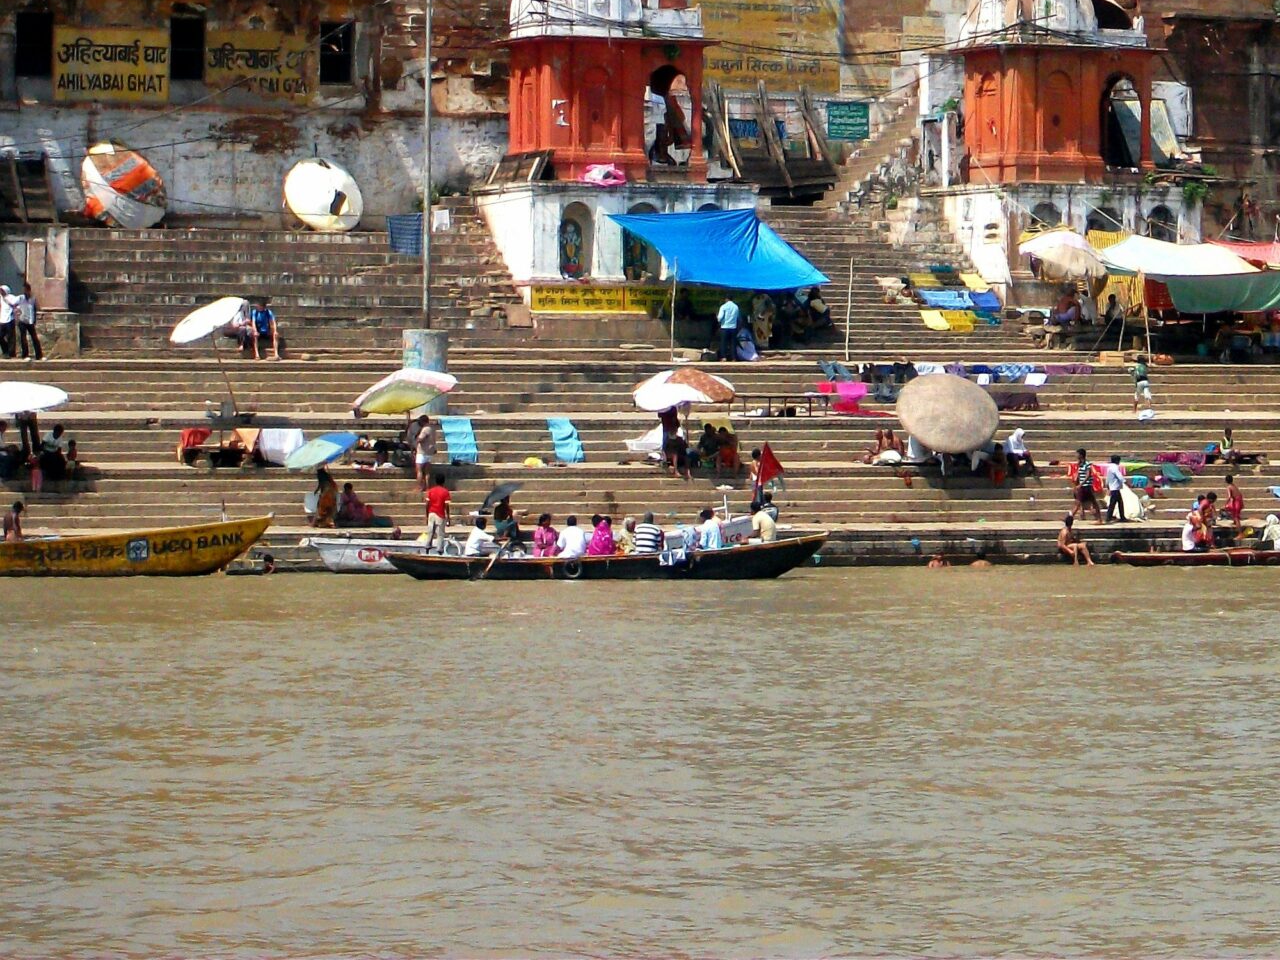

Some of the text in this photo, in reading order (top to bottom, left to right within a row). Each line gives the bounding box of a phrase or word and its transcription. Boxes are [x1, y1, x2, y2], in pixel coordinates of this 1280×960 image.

[57, 37, 168, 66] अहिल्याबाई घाट
[57, 73, 166, 93] AHILYABAI GHAT
[153, 531, 244, 554] UCO BANK
